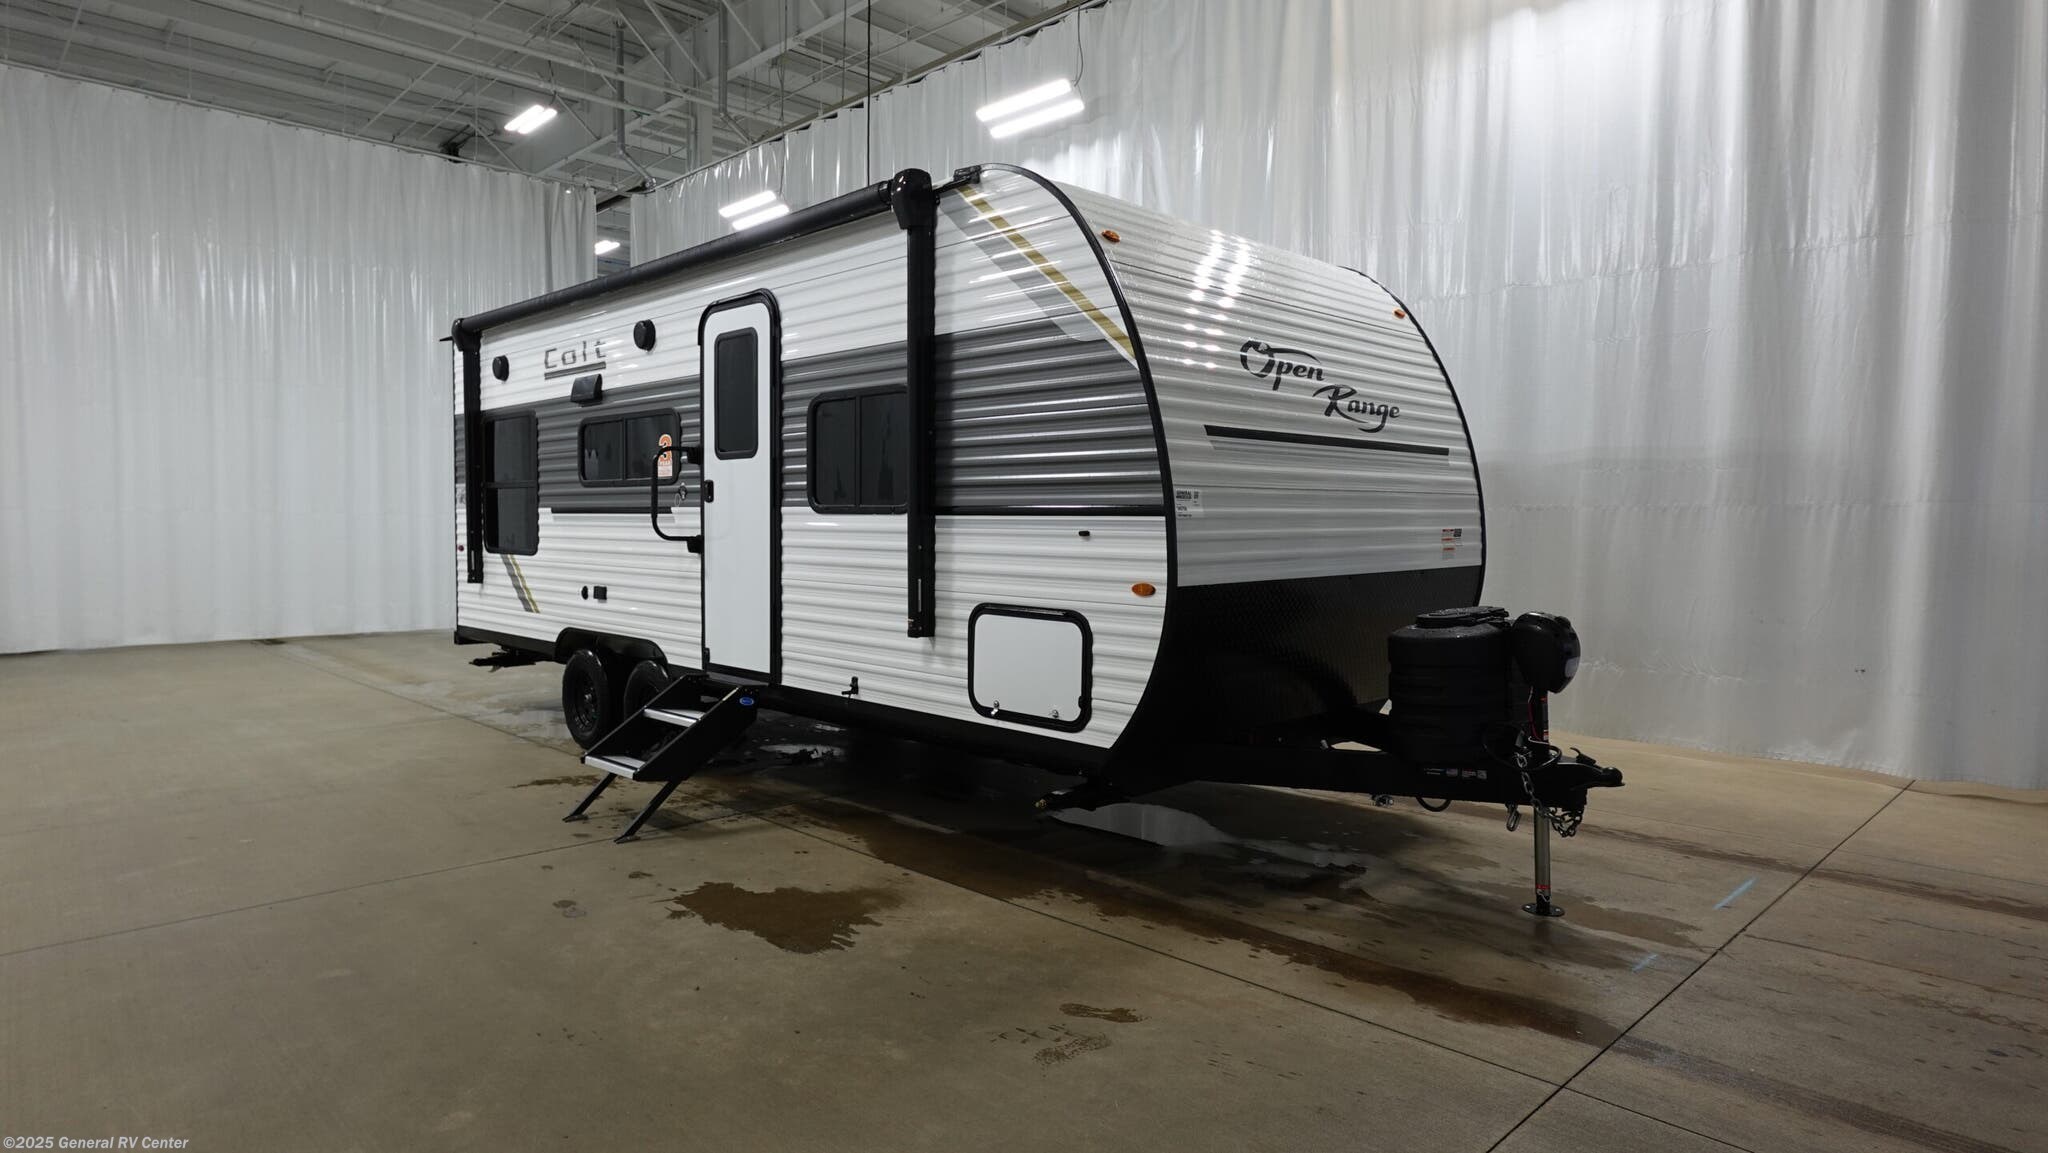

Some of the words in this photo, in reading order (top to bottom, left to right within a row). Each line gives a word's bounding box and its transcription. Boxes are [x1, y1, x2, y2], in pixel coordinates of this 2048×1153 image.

[544, 340, 606, 369] Colt
[1240, 340, 1325, 391] Open
[1312, 384, 1400, 433] Range
[658, 433, 673, 463] 3
